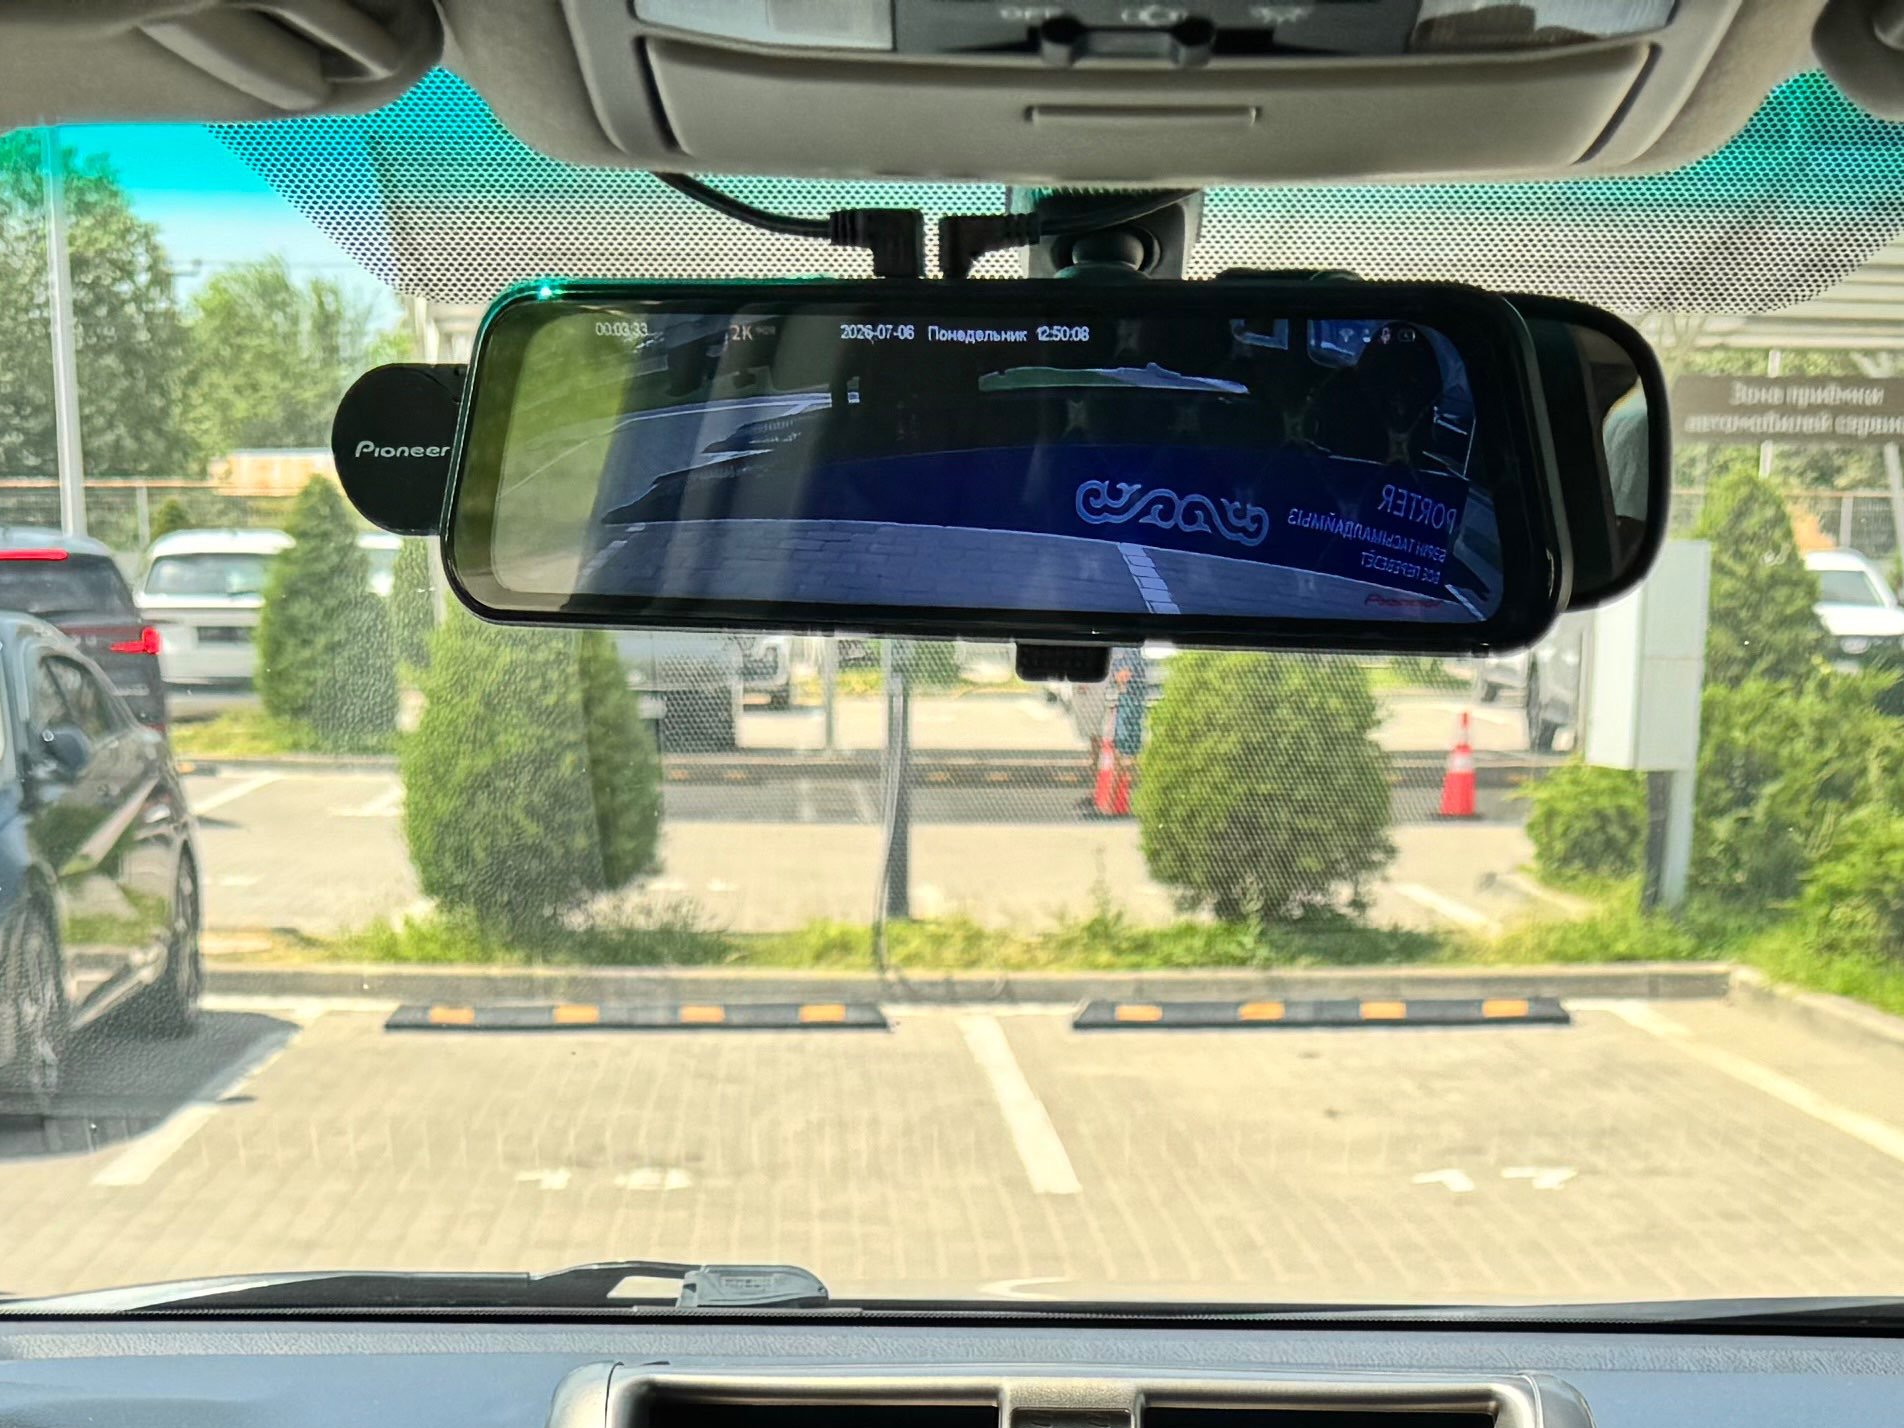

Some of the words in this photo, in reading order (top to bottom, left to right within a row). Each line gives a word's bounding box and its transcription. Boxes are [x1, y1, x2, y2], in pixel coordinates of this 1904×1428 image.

[729, 324, 754, 341] 2K
[840, 324, 915, 340] 2026-07-06
[928, 325, 1028, 344] Понедельник
[1036, 326, 1090, 342] 12:50:08
[1730, 381, 1784, 406] Зона
[355, 440, 451, 458] Pioneer
